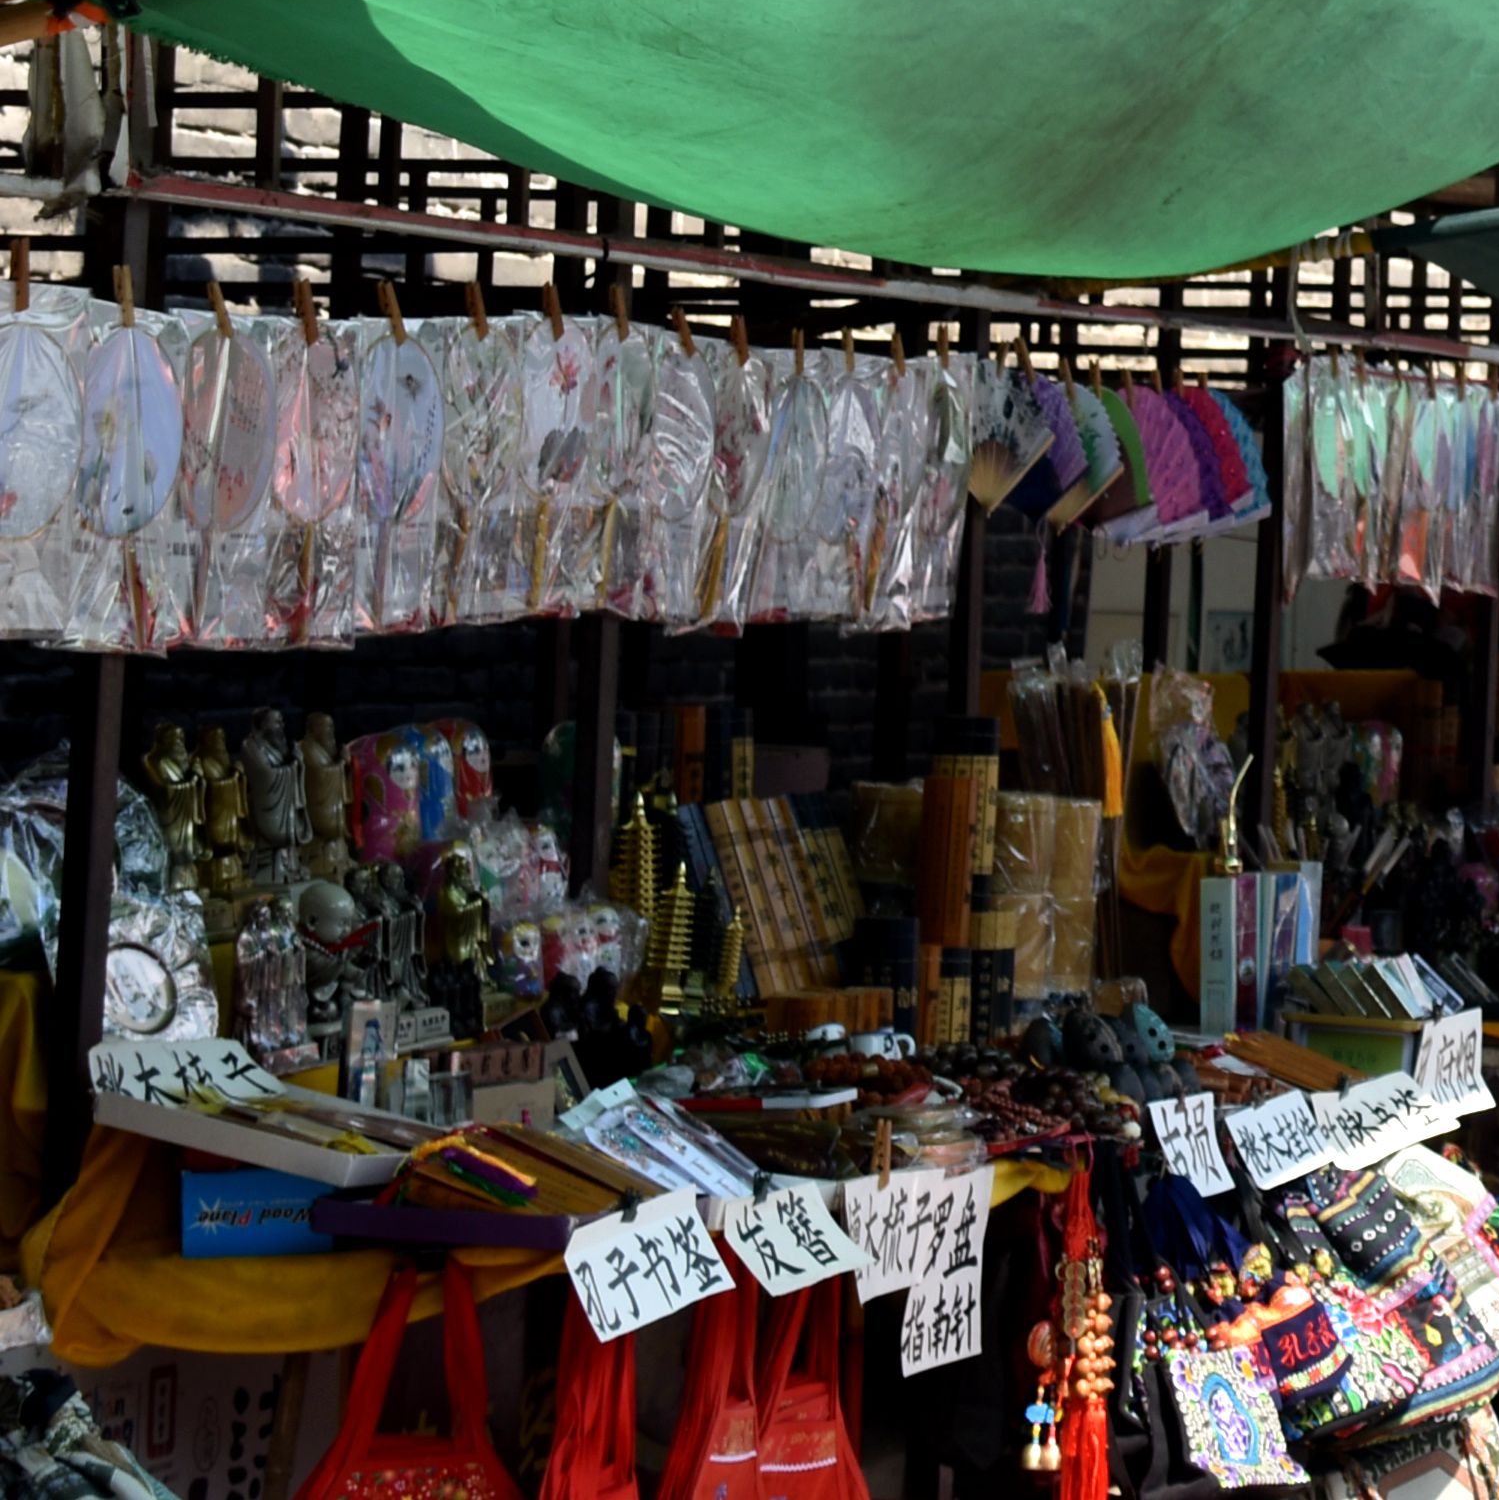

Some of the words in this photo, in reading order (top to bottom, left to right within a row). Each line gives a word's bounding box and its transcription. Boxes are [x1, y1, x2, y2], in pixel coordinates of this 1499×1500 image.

[197, 1208, 254, 1227] Plane
[923, 1182, 979, 1280] 罗盘
[574, 1214, 724, 1335] 孔子书签
[902, 1281, 978, 1364] 指南针
